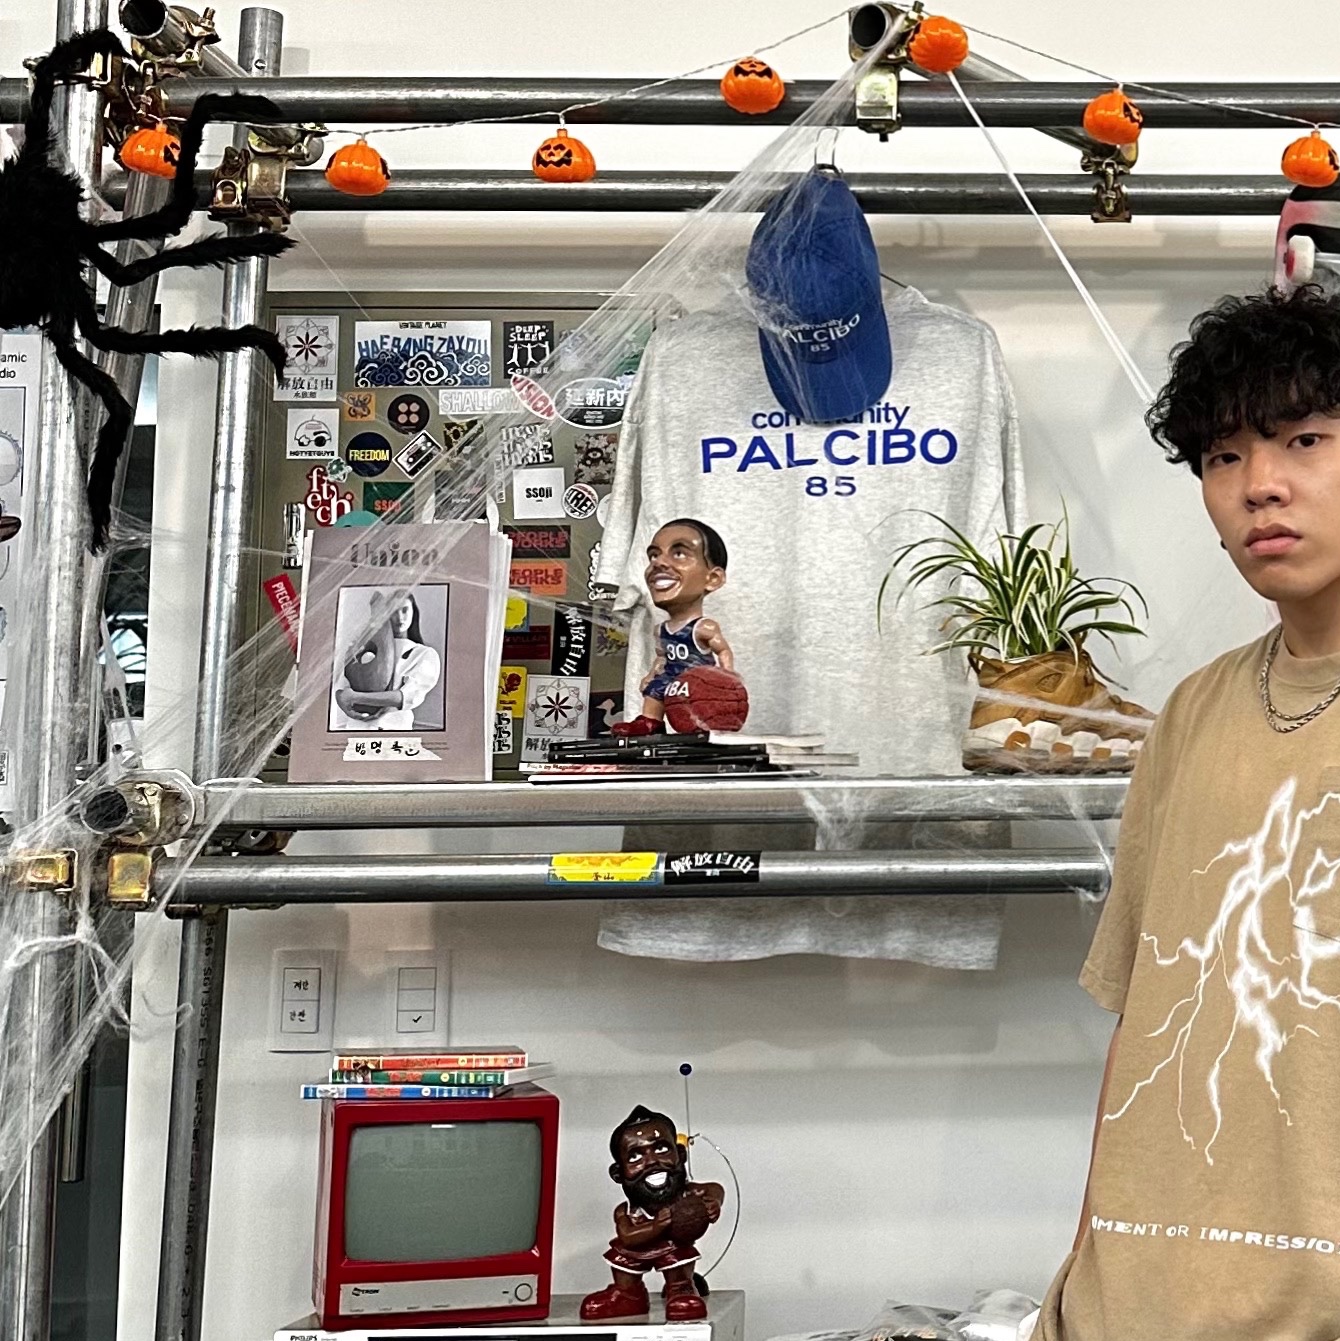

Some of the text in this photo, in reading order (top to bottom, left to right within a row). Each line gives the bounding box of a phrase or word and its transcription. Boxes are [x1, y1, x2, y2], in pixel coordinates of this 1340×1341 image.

[509, 332, 546, 341] SLEEP
[781, 314, 860, 343] ALCIBO
[349, 450, 389, 461] FREEDOM
[701, 428, 958, 473] PALCIBO
[805, 475, 857, 497] 85
[667, 644, 689, 660] 30
